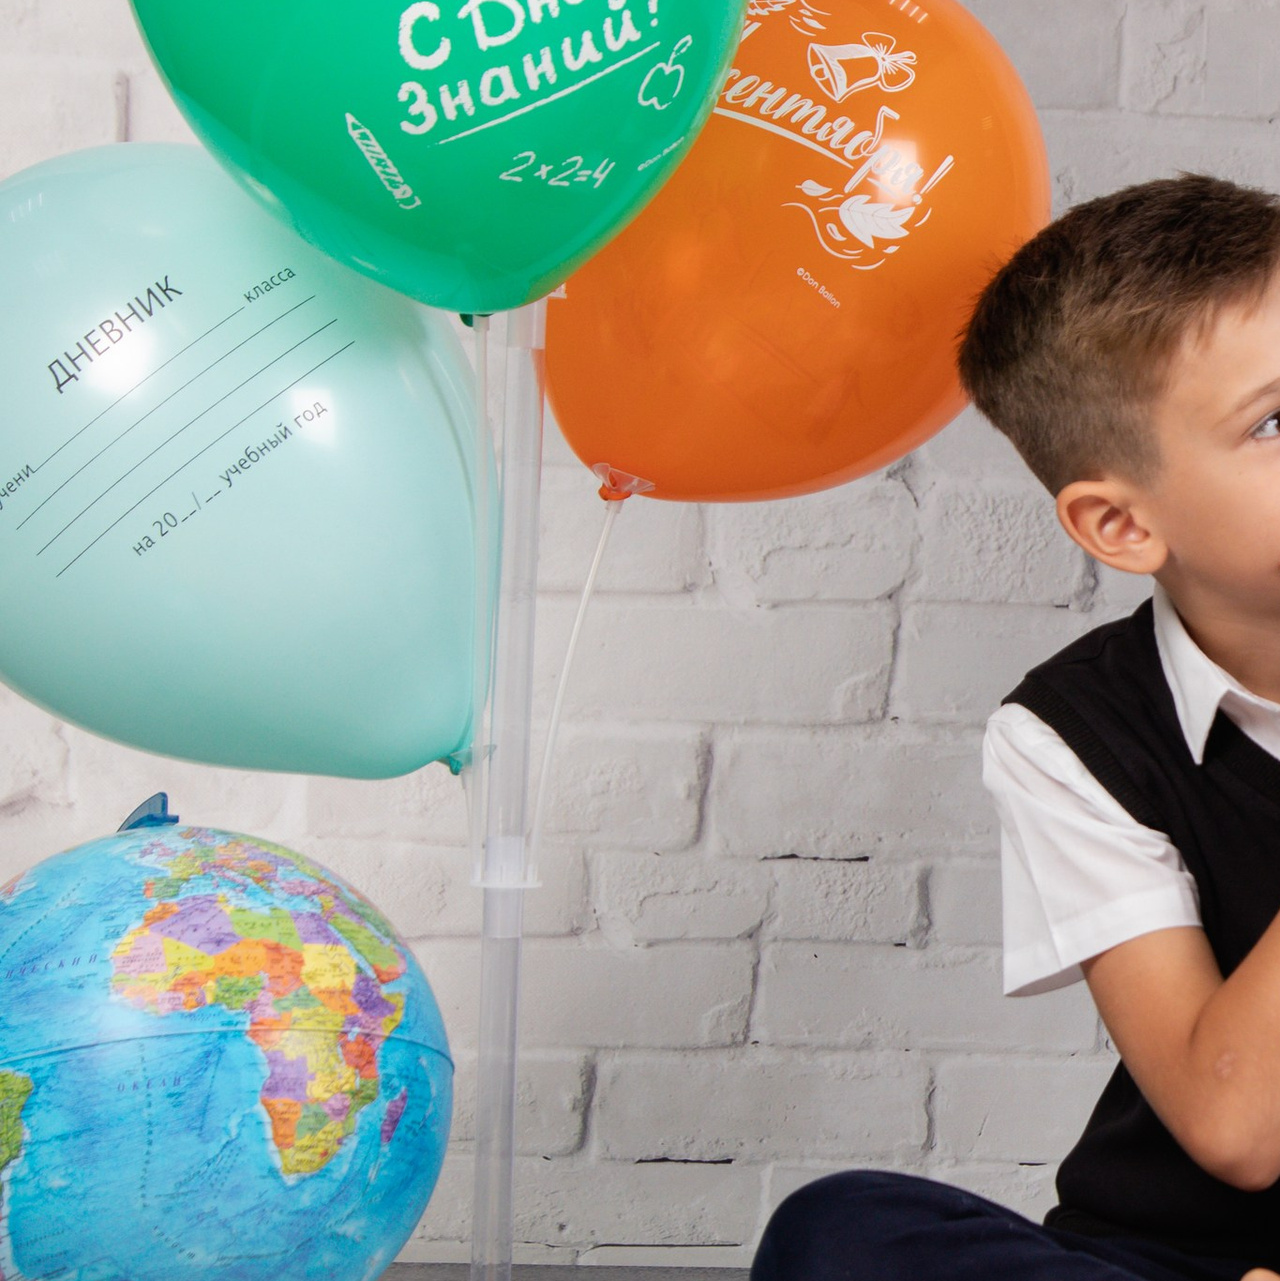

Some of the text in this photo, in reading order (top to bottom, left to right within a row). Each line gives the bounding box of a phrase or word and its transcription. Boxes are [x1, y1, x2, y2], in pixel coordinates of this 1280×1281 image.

[398, 1, 452, 71] С
[0, 267, 297, 510] чени класса
[47, 275, 184, 394] ДНЕВНИК
[132, 534, 156, 557] на
[218, 422, 294, 488] учебный
[293, 401, 328, 429] год
